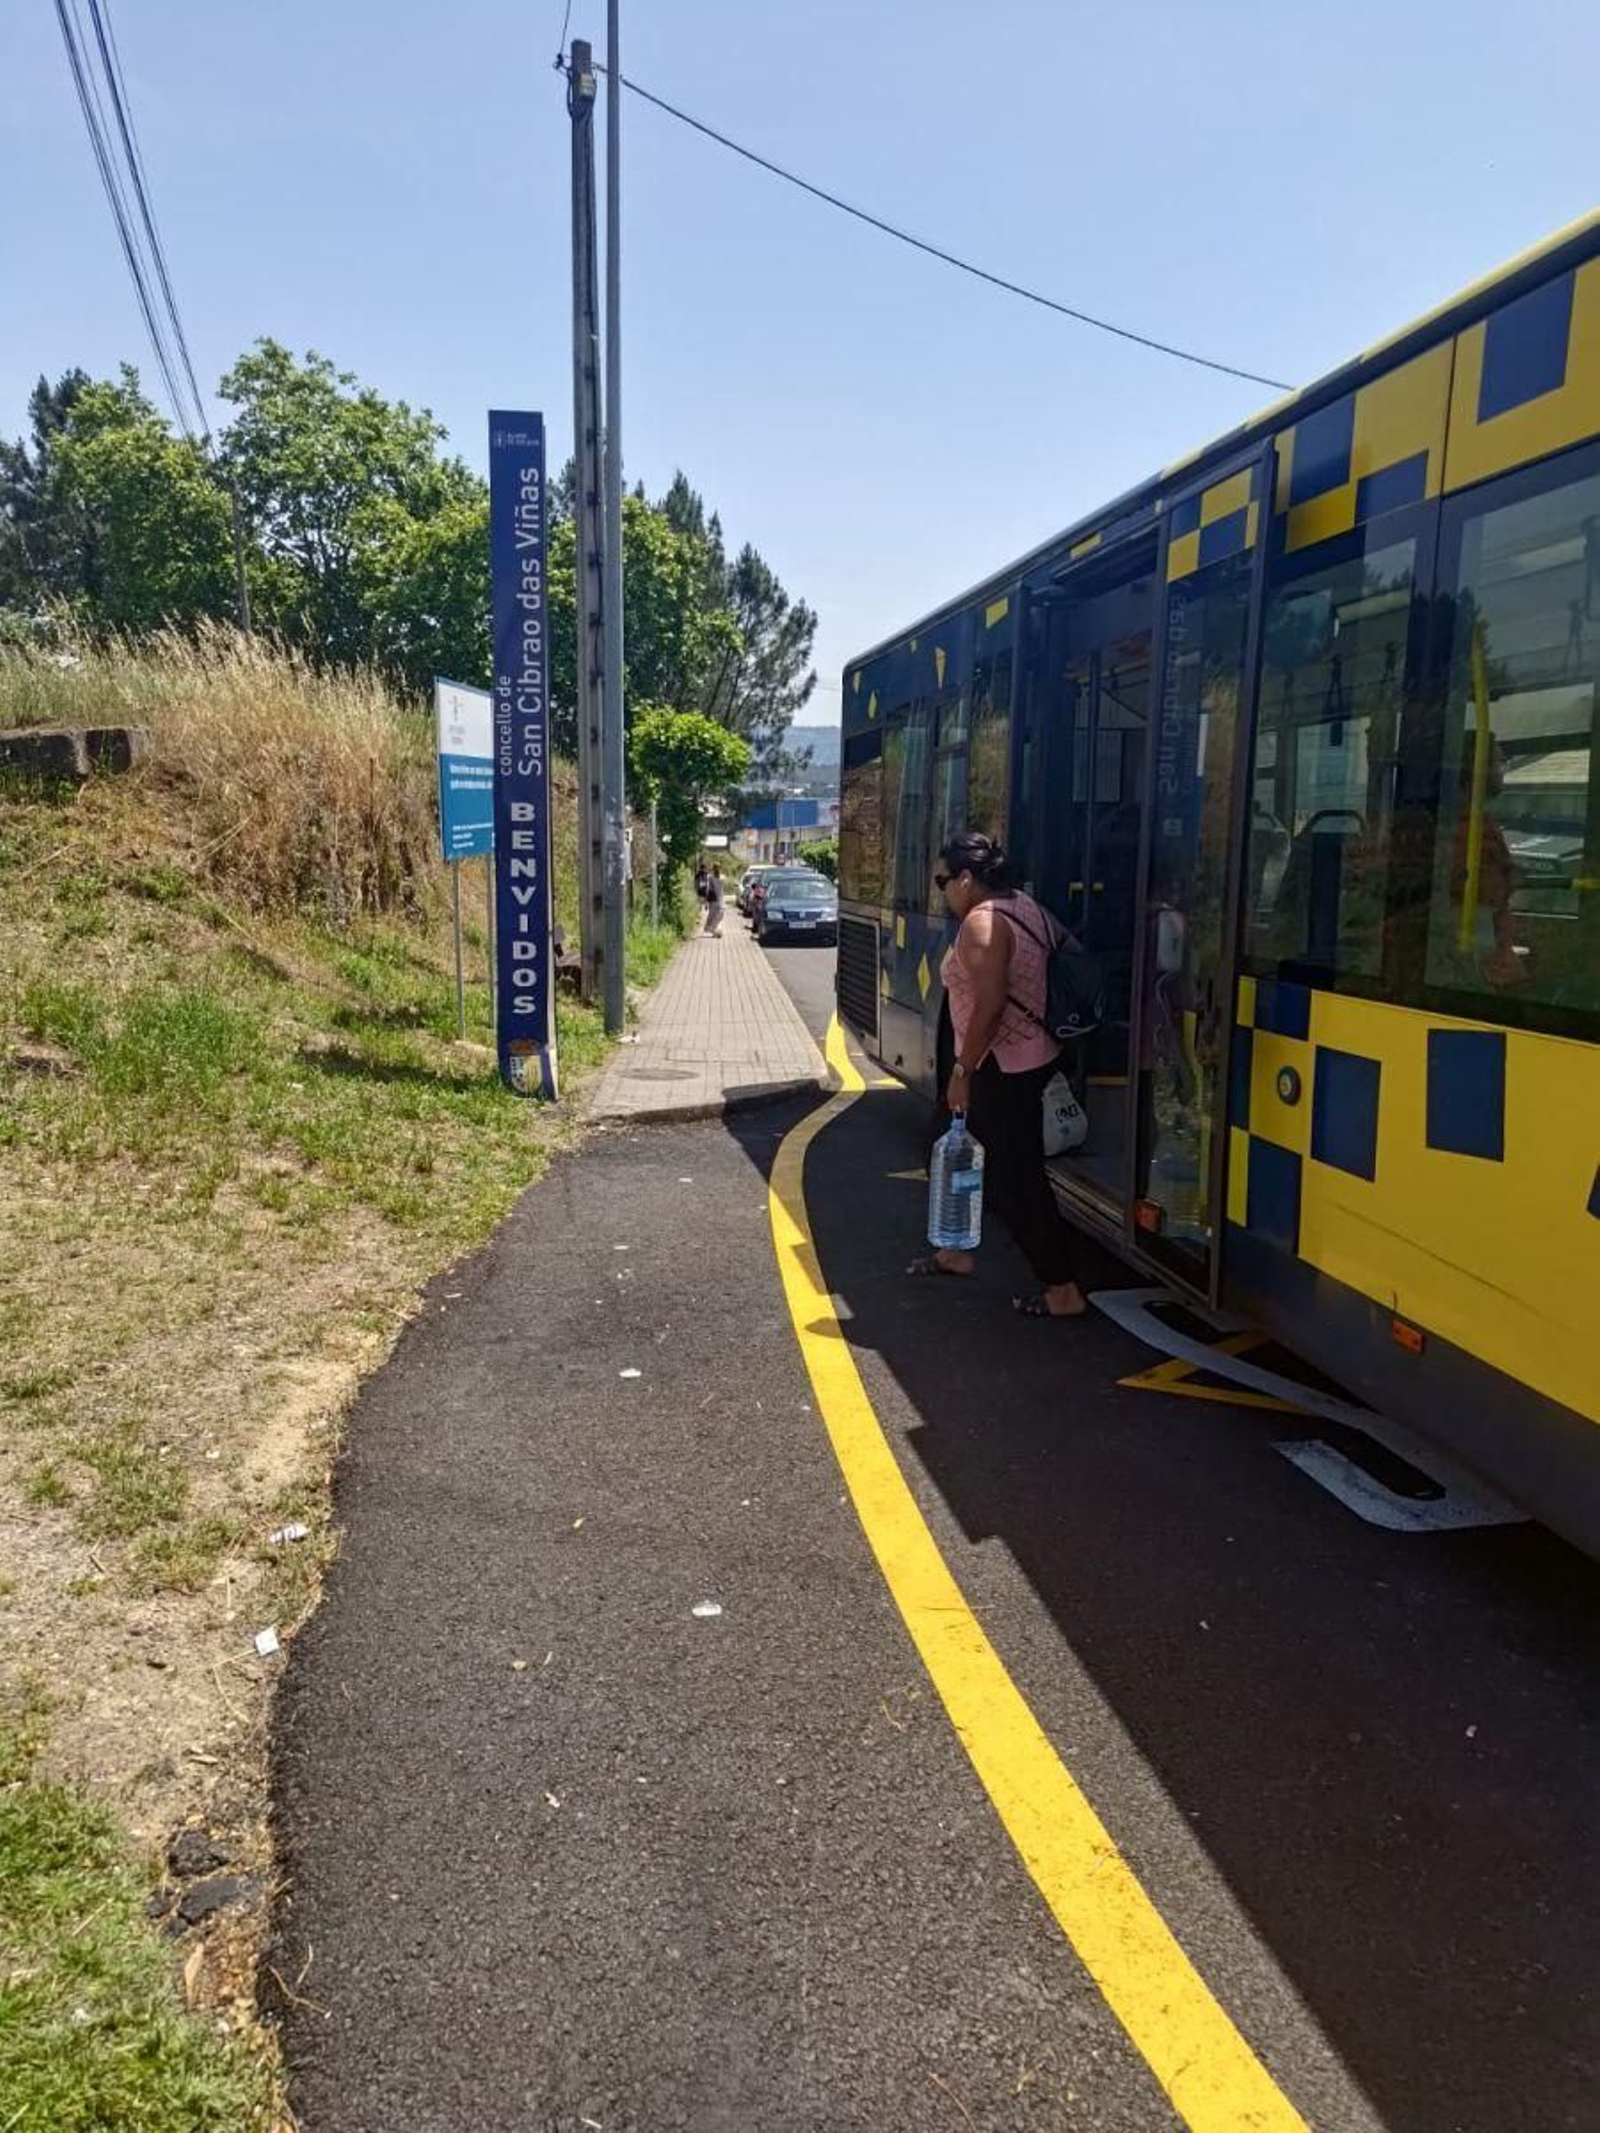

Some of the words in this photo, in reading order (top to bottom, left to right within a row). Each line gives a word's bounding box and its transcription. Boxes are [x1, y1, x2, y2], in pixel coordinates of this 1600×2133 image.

[514, 467, 540, 550] Viñas
[515, 558, 541, 610] das
[499, 675, 512, 696] de
[516, 618, 542, 713] Cibrao
[498, 702, 512, 777] concello
[517, 723, 542, 777] San
[510, 801, 537, 1015] BENVIDOS
